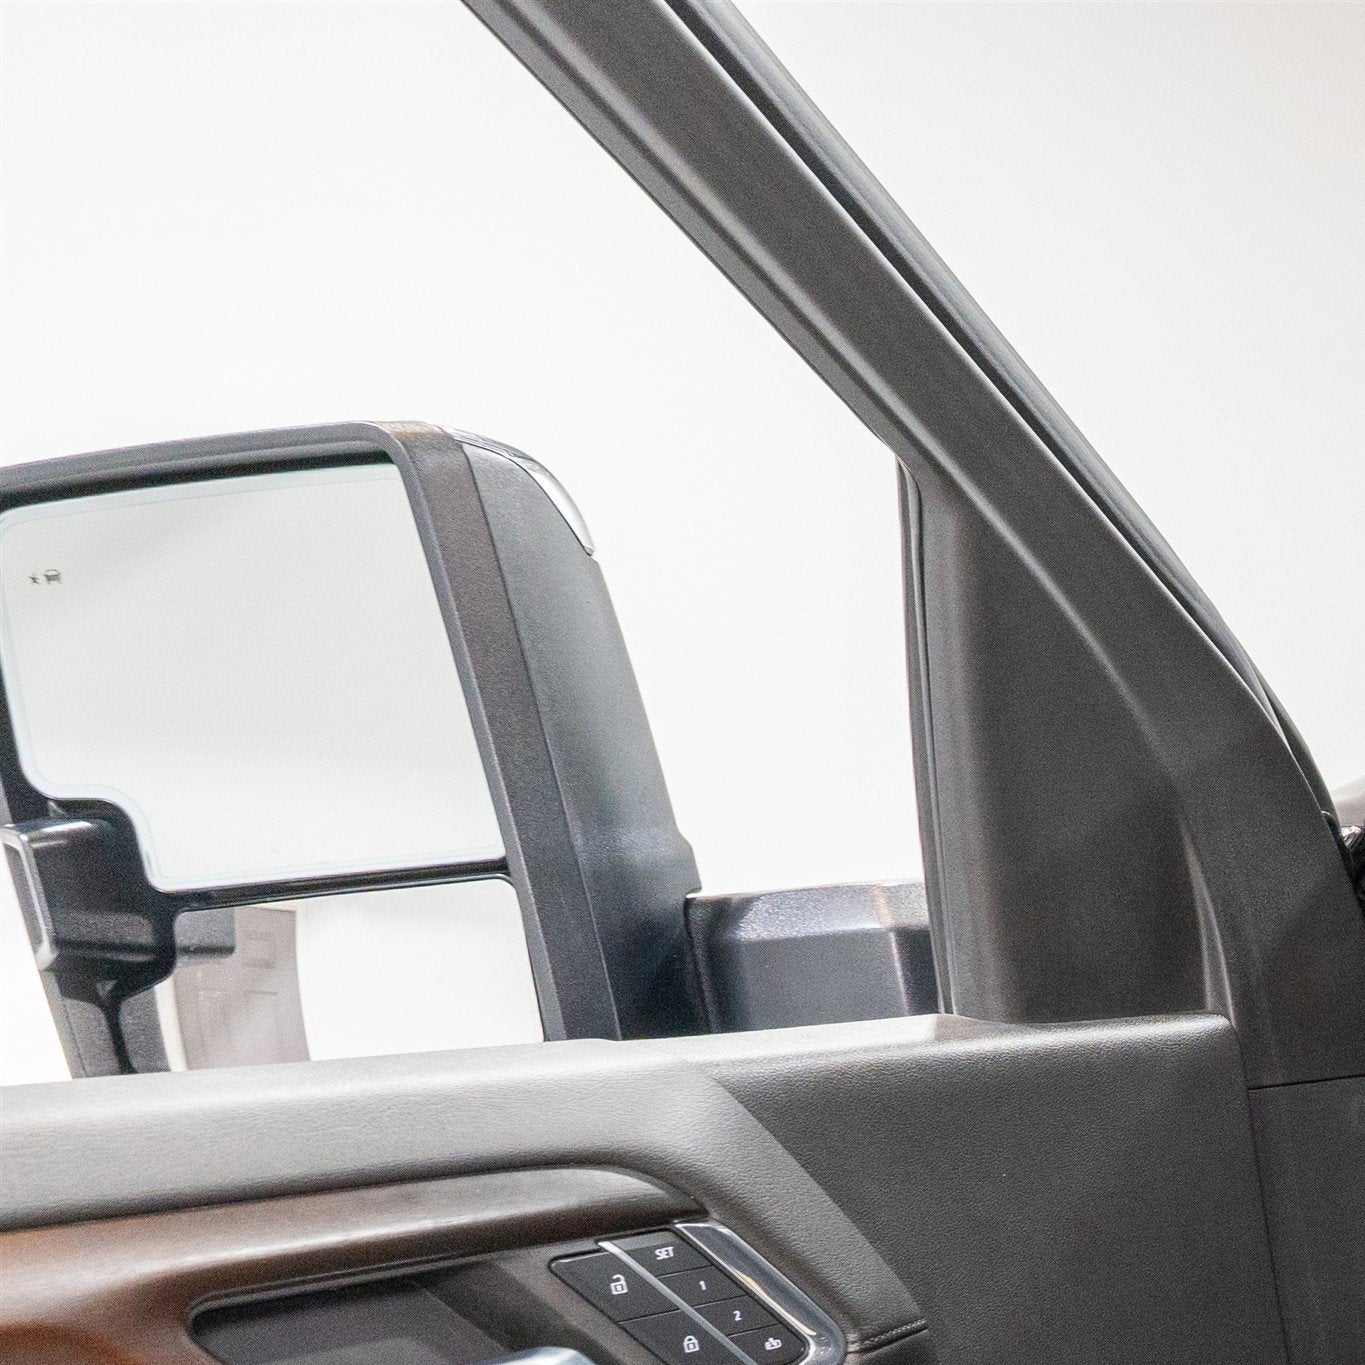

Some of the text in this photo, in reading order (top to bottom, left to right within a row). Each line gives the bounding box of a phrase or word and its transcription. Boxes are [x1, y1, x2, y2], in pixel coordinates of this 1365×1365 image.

[654, 1246, 674, 1260] SET
[699, 1280, 707, 1291] 1
[733, 1310, 742, 1322] 2
